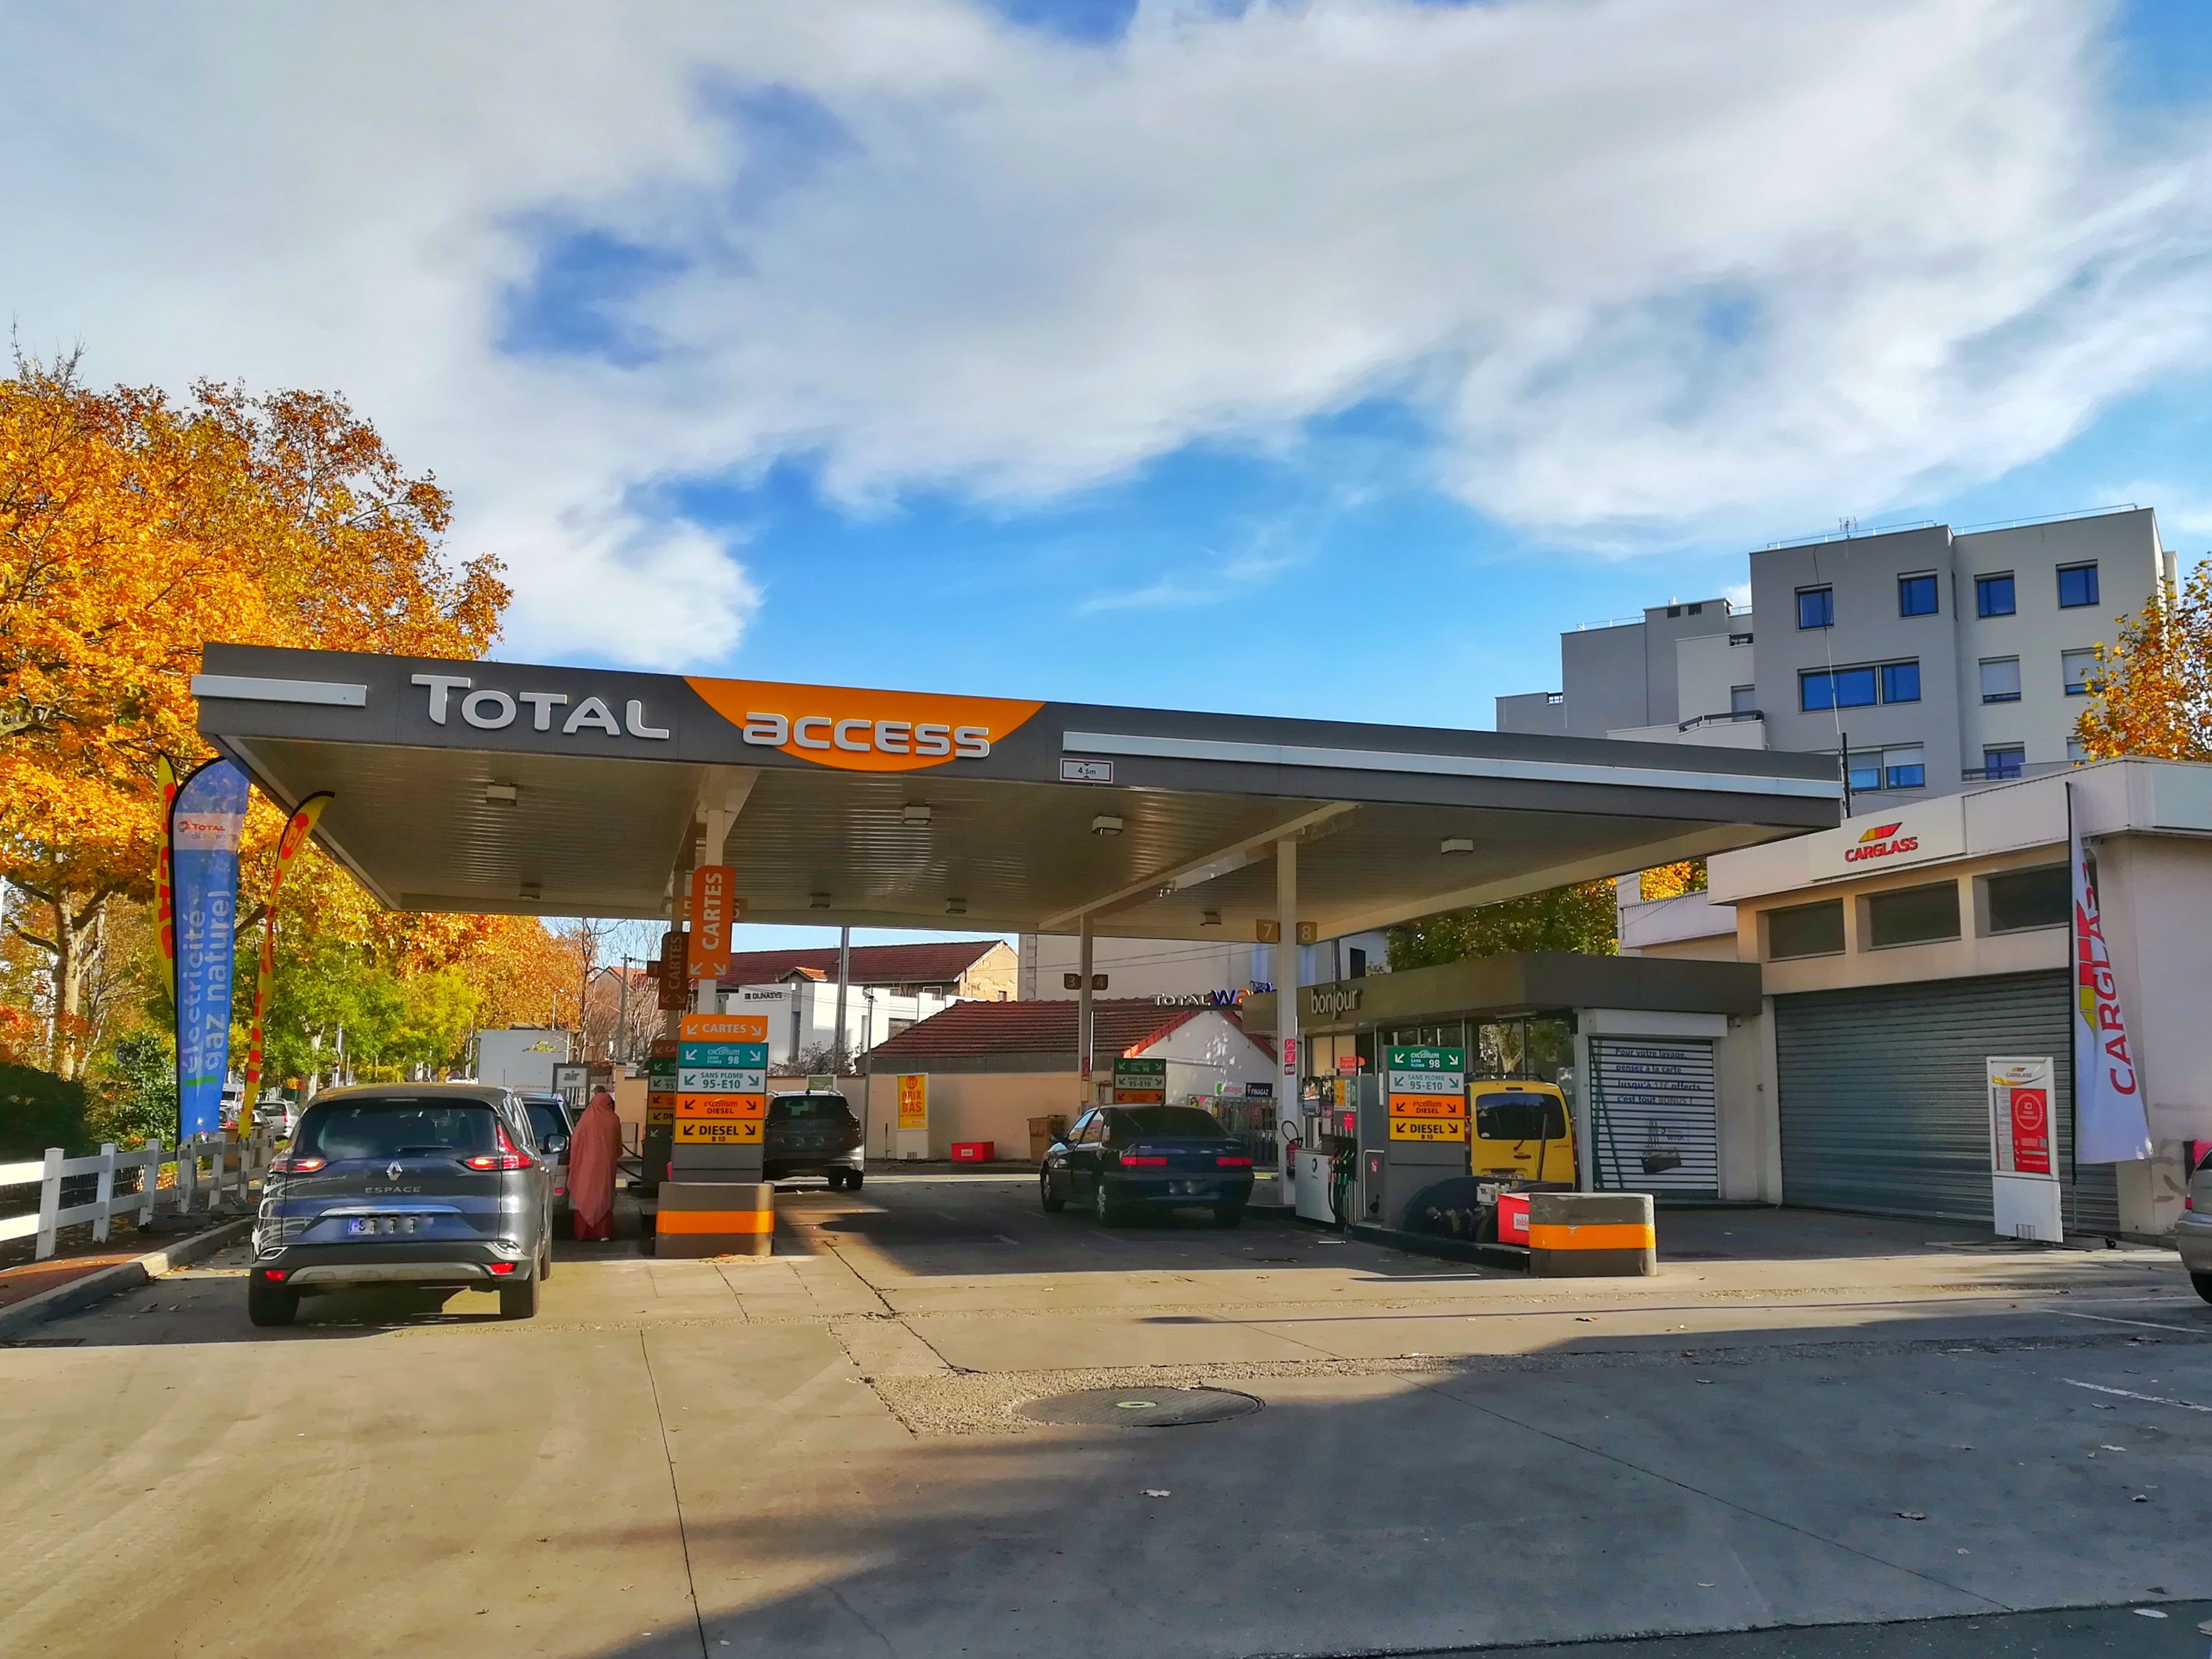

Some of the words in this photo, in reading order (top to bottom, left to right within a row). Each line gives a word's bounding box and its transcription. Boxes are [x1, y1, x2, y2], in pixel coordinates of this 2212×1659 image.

[411, 674, 669, 739] TOTAL
[1845, 836, 1918, 862] CARGLASS
[702, 873, 722, 950] CARTES
[1264, 924, 1273, 939] 7
[1301, 925, 1311, 941] 8
[205, 890, 231, 1001] naturel
[668, 936, 682, 990] CARTES
[1068, 976, 1075, 987] 3
[1096, 977, 1104, 988] 4
[182, 910, 205, 1073] électricité
[1150, 992, 1211, 1006] TOTAL
[1311, 984, 1358, 1020] bonjour
[702, 1024, 747, 1033] CARTES
[205, 1013, 226, 1071] gaz
[707, 1047, 740, 1055] excellium
[1411, 1050, 1440, 1059] excellium
[727, 1056, 739, 1065] 98
[1429, 1059, 1440, 1068] 98
[564, 1070, 580, 1081] air
[703, 1080, 741, 1089] 95-E10
[1410, 1082, 1443, 1090] 95-E10
[704, 1098, 738, 1107] excellium
[902, 1101, 922, 1113] BAS
[1413, 1098, 1442, 1107] excellium
[699, 1125, 739, 1135] DIESEL
[1410, 1124, 1444, 1133] DIESEL
